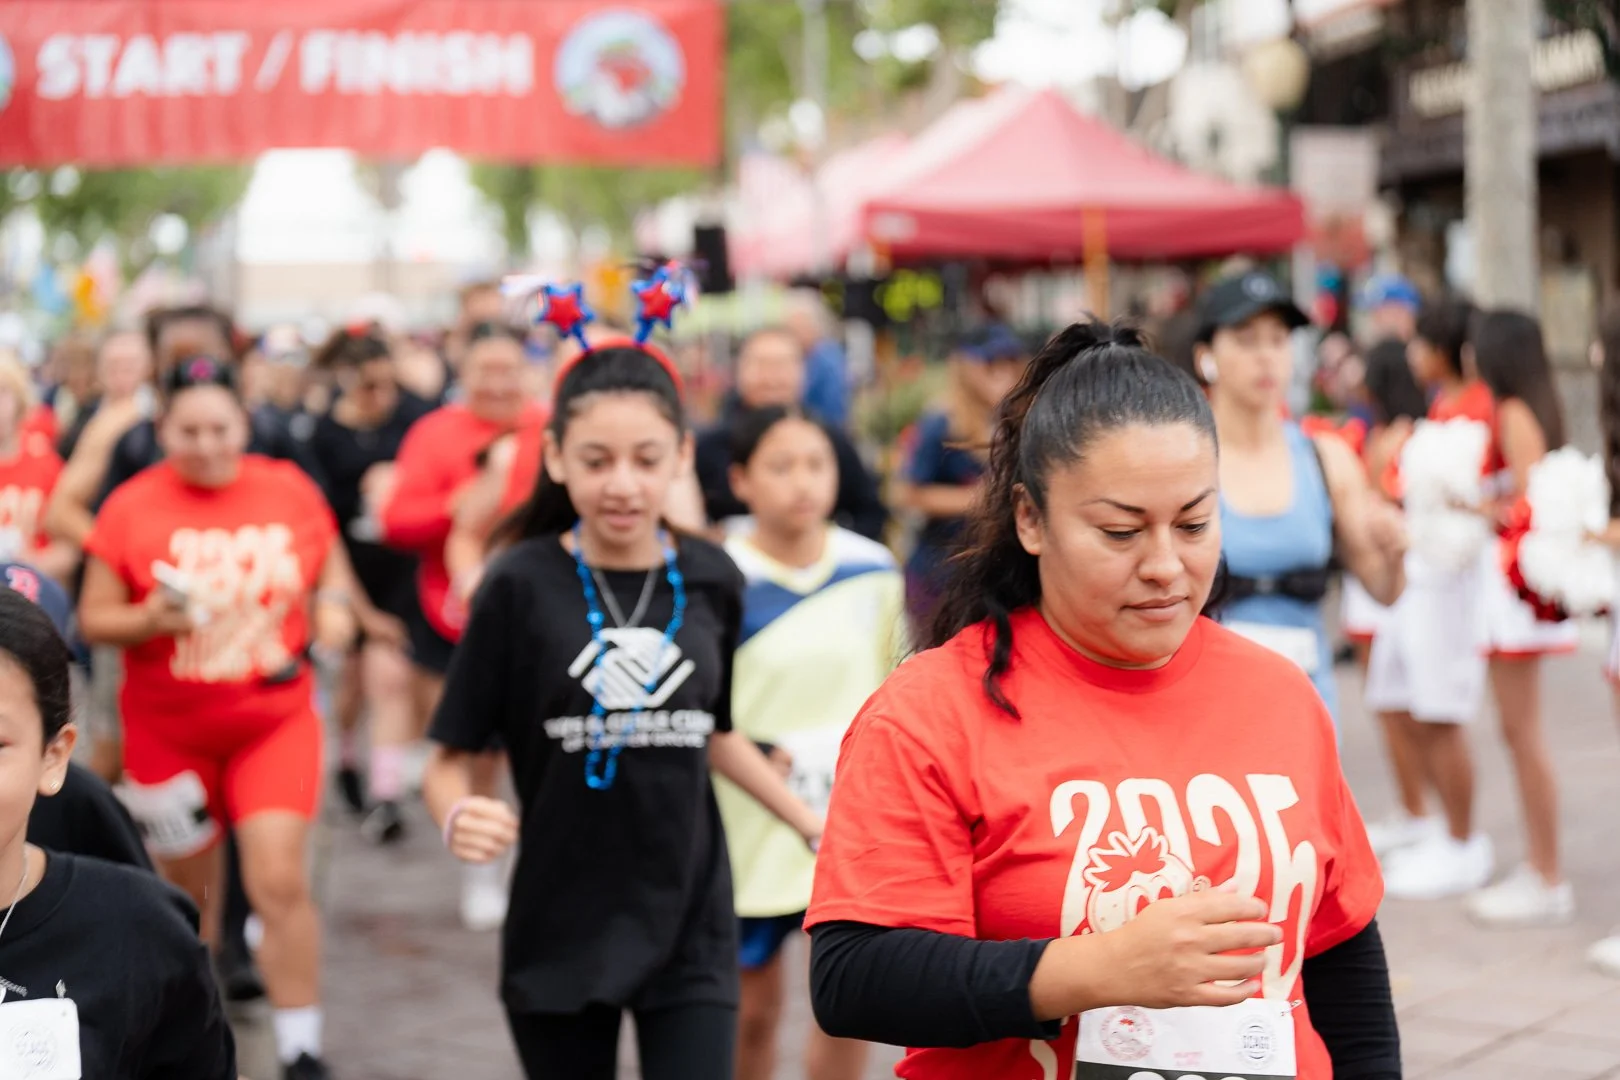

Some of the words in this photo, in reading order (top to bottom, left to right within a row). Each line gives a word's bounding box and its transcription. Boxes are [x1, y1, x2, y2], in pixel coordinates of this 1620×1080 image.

[37, 32, 249, 98] START
[302, 35, 535, 94] FINISH
[1050, 774, 1316, 1002] 2025
